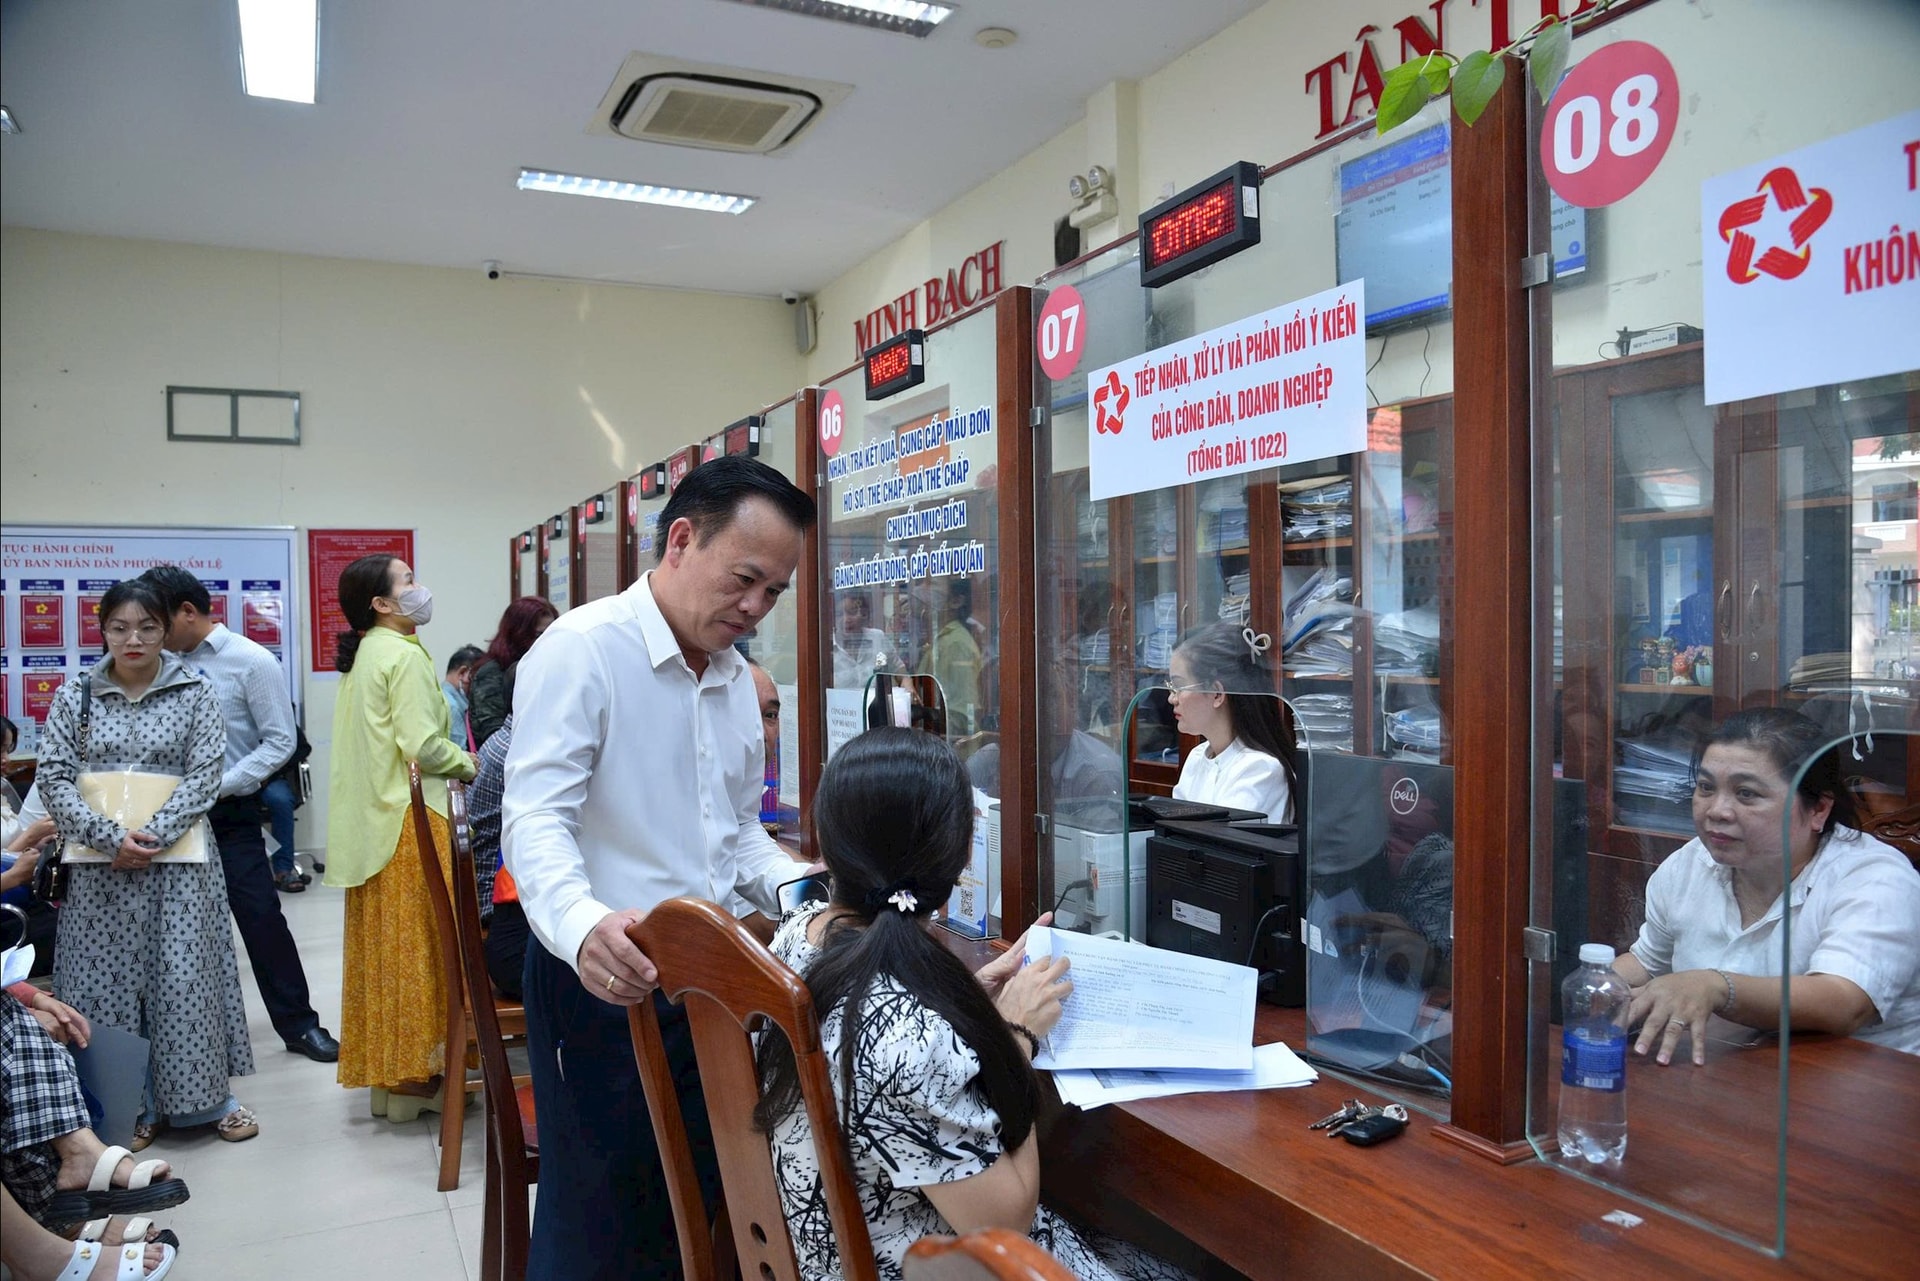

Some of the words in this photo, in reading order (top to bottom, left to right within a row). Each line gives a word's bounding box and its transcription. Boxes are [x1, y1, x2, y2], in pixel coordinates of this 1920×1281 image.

[1554, 74, 1659, 174] 08
[854, 288, 918, 361] MINH
[1042, 304, 1079, 360] 07
[1135, 360, 1155, 398] TIẾP
[1159, 355, 1191, 393] NHẬN,
[1194, 341, 1209, 379] XỬ
[1212, 338, 1224, 375] LÝ
[1228, 334, 1243, 370] VÀ
[1247, 320, 1281, 364] PHẢN
[1284, 309, 1305, 354] HỒI
[1310, 308, 1318, 346] Ý
[1323, 294, 1356, 343] KIẾN
[822, 404, 841, 440] 06
[1152, 402, 1172, 440] CỦA
[1176, 401, 1204, 434] CÔNG
[1208, 390, 1235, 427] DÂN,
[1238, 382, 1279, 420] DOANH
[1284, 363, 1333, 410] NGHIỆP
[865, 438, 878, 469] KẾT
[900, 428, 923, 458] CUNG
[925, 414, 943, 450] CẤP
[945, 406, 967, 445] MẪU
[969, 405, 991, 437] ĐƠN
[1187, 440, 1222, 476] (TỔNG
[1226, 437, 1246, 467] ĐÀI
[1250, 431, 1287, 460] 1022)
[867, 475, 882, 507] THẾ
[906, 465, 923, 497] XOÁ
[925, 456, 942, 492] THẾ
[944, 450, 969, 487] CHẤP
[887, 504, 919, 541] CHUYỂN
[920, 507, 941, 539] MỤC
[942, 498, 966, 531] ĐÍCH
[25, 559, 50, 568] BAN
[835, 562, 854, 589] ĐĂNG
[855, 558, 865, 586] KÝ
[866, 553, 884, 585] BIẾN
[911, 544, 928, 579] CẤP
[930, 541, 951, 576] GIẤY
[953, 543, 968, 579] DỰ
[968, 539, 984, 573] ÁN
[1394, 790, 1415, 802] DELL
